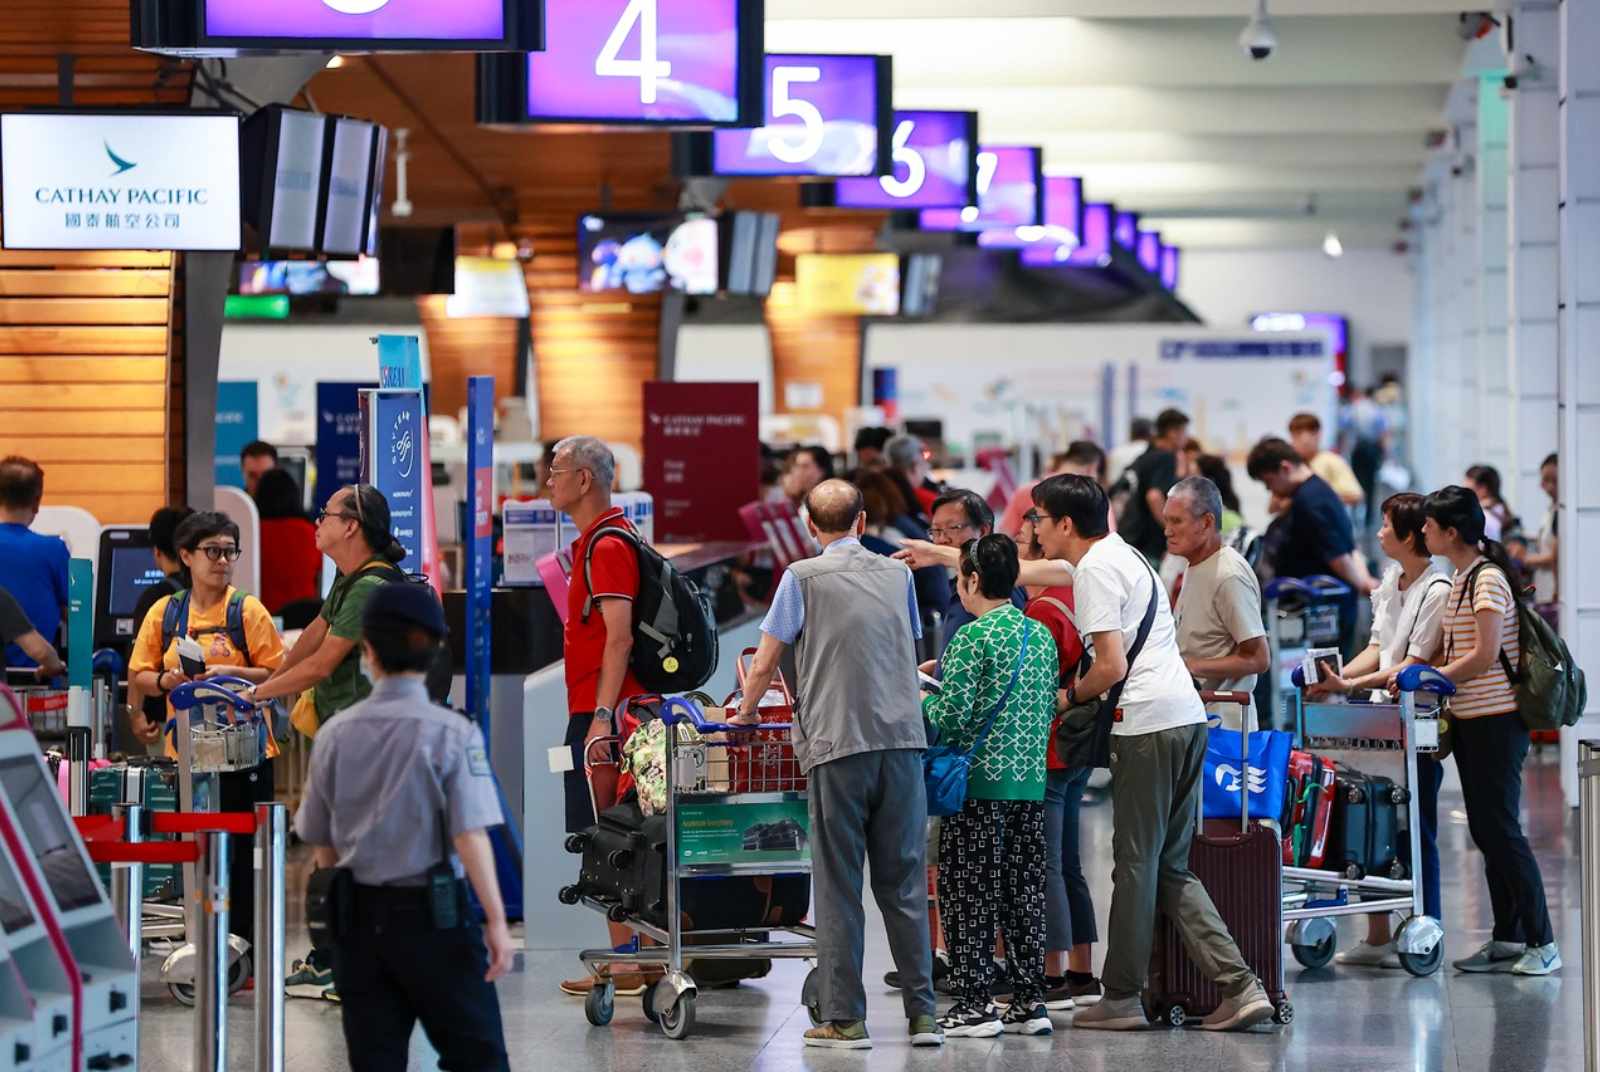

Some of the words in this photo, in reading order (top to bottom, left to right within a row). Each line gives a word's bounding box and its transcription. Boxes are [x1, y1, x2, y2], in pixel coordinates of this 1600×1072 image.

[595, 0, 671, 103] 4
[768, 66, 824, 163] 5
[35, 188, 121, 204] CATHAY
[127, 188, 209, 205] PACIFIC
